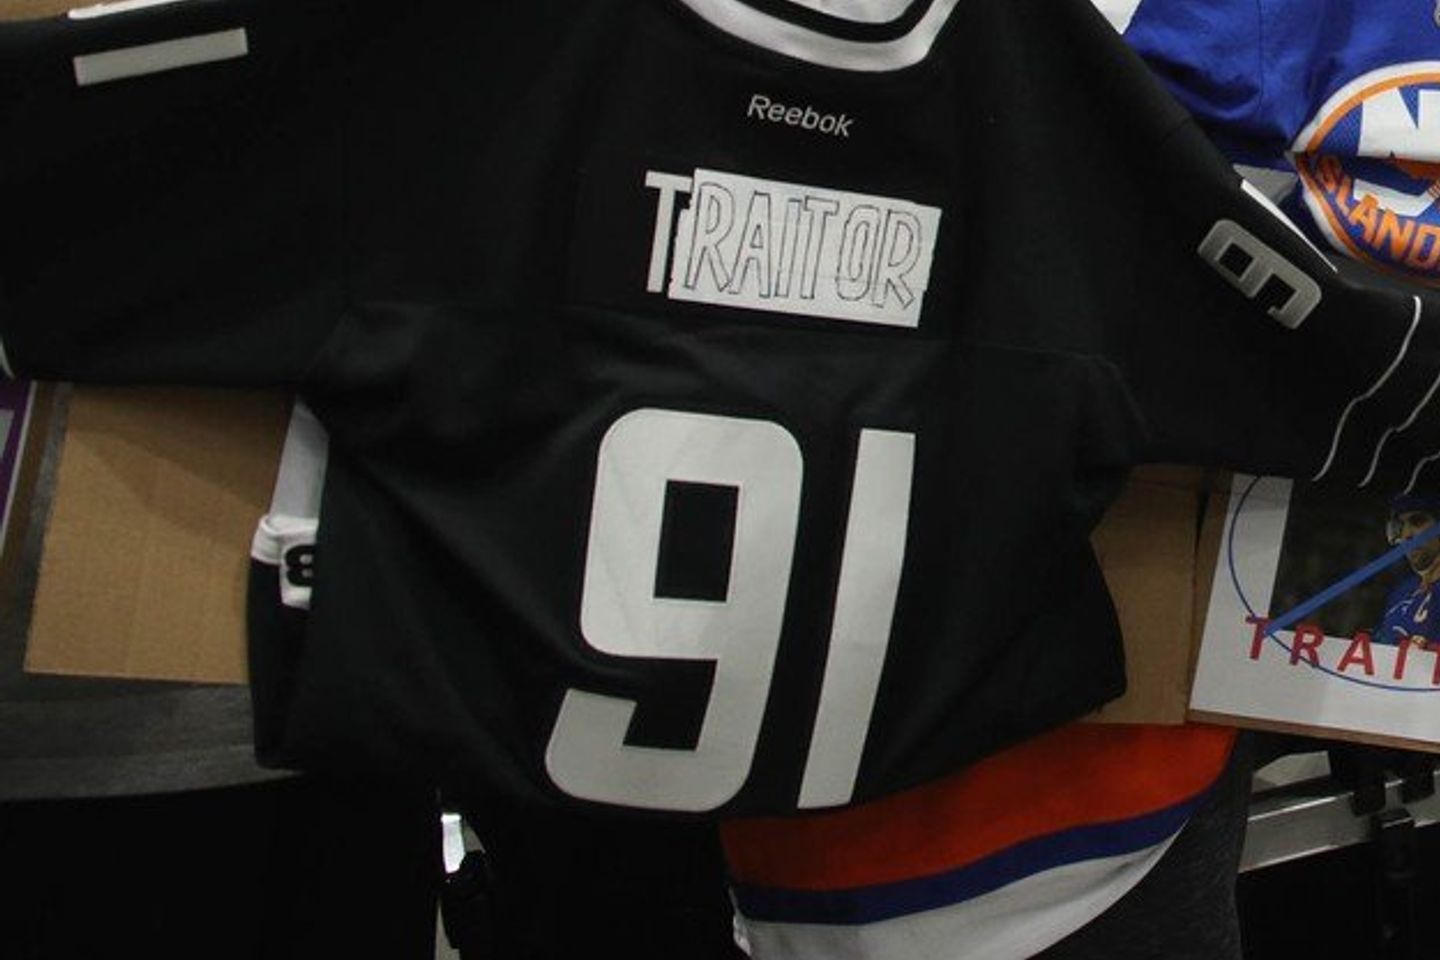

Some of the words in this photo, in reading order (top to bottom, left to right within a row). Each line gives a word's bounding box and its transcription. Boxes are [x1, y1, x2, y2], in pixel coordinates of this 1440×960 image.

[746, 93, 854, 137] Reebok
[645, 170, 922, 311] TRAITOR
[1197, 179, 1338, 329] 9
[545, 407, 916, 812] 91
